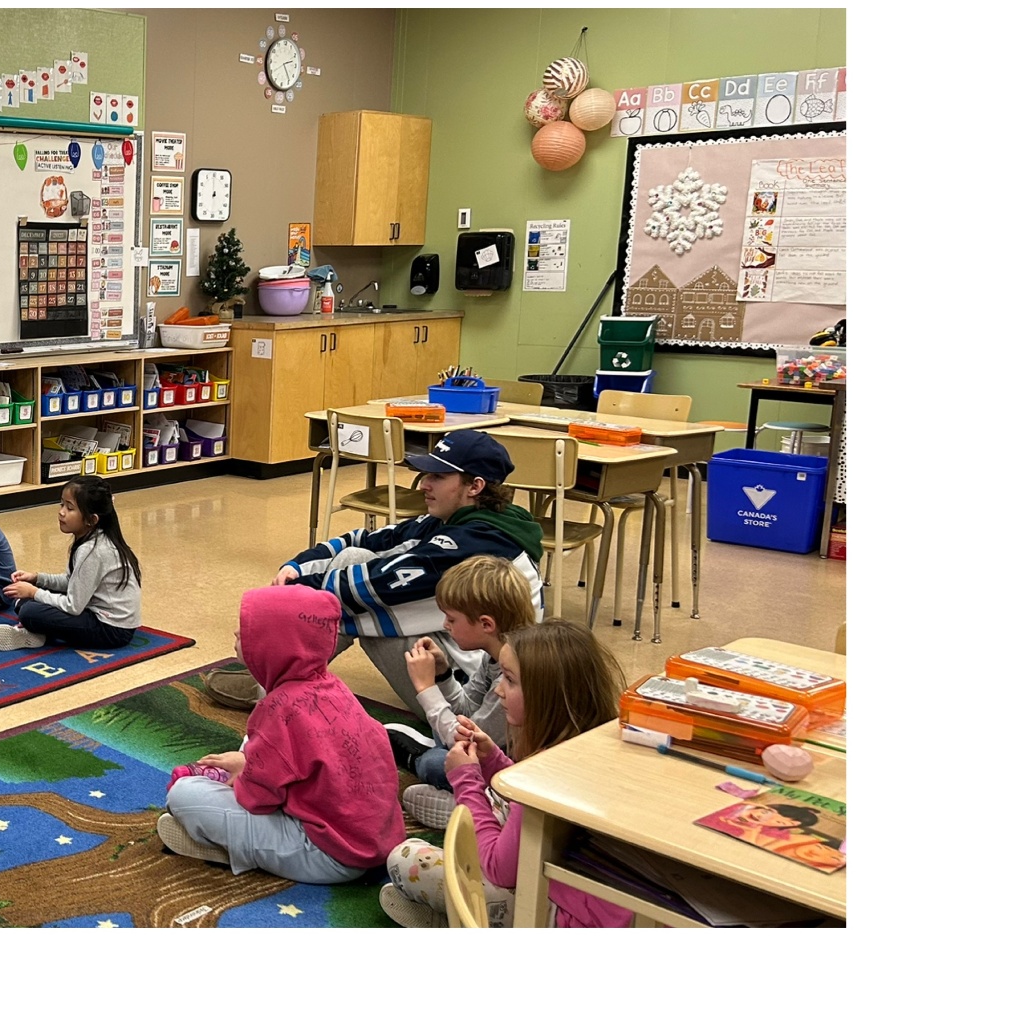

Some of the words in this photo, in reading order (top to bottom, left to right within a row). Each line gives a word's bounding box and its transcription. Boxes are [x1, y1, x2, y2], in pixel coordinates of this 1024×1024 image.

[725, 78, 750, 97] Dd
[764, 76, 789, 93] Ee
[805, 72, 829, 91] Ff
[617, 91, 642, 107] Aa
[652, 87, 675, 103] Bb
[688, 83, 712, 100] Cc
[737, 509, 778, 522] CANADA'S
[380, 553, 426, 590] 14
